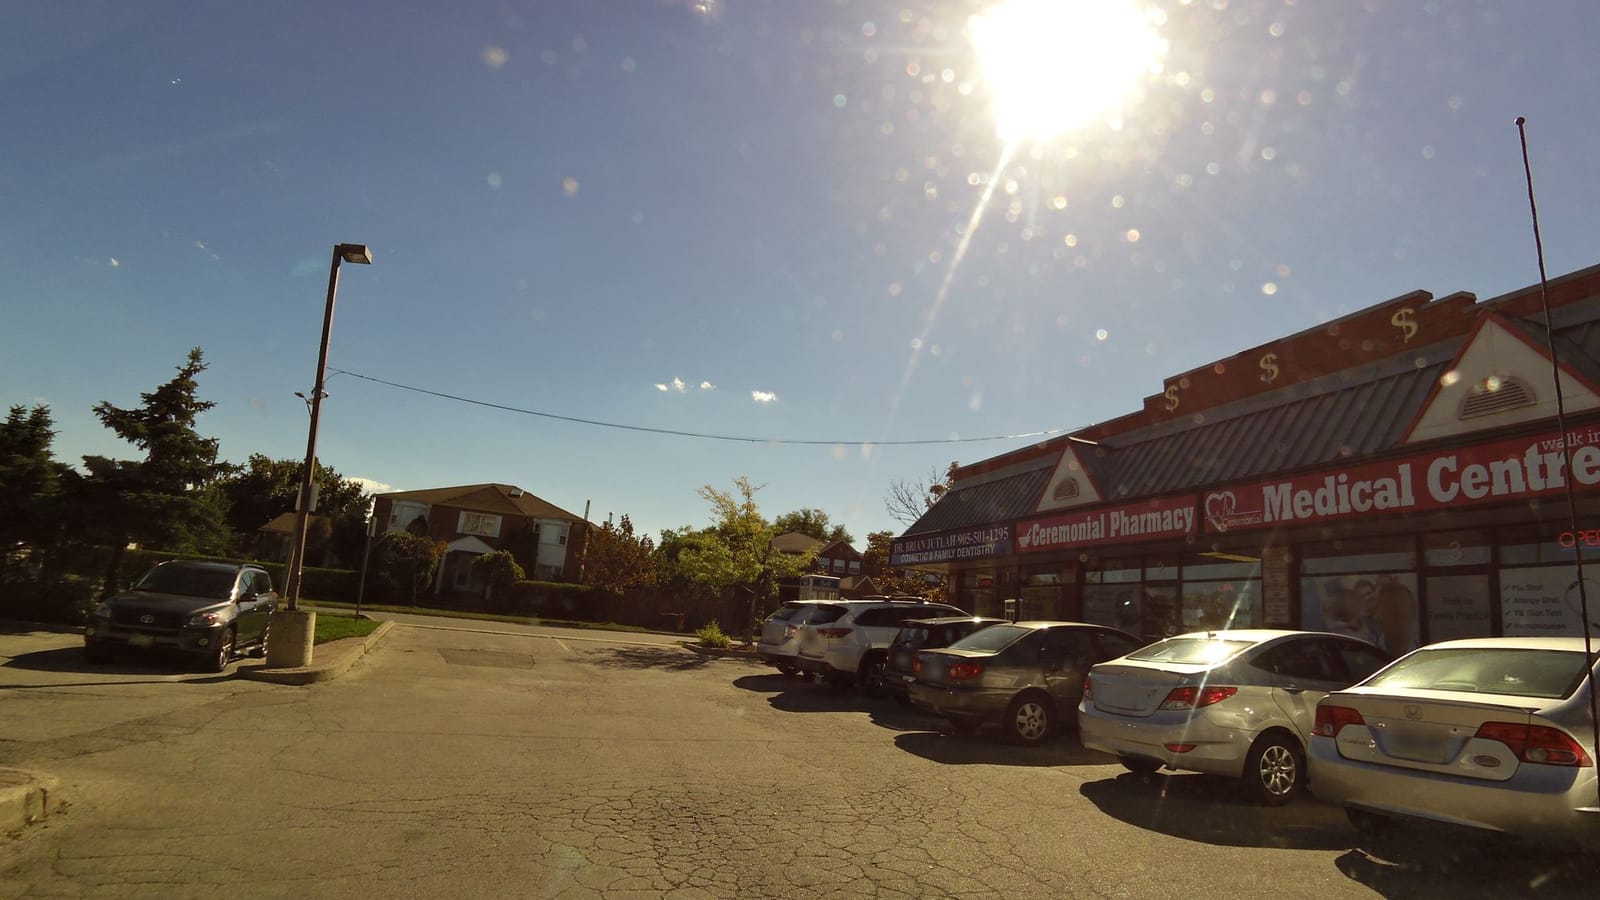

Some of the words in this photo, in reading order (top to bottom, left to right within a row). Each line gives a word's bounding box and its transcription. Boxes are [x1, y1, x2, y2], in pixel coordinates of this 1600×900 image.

[1541, 432, 1584, 450] walk
[1263, 463, 1415, 523] Medical
[1427, 441, 1600, 503] Centre
[1032, 512, 1105, 547] Ceremonial
[1110, 506, 1195, 538] Pharmacy
[900, 551, 929, 563] COSMETIC
[934, 548, 956, 560] FAMILY
[957, 543, 996, 558] DENTISTRY
[906, 538, 928, 553] BRIAN
[1448, 540, 1463, 560] 3
